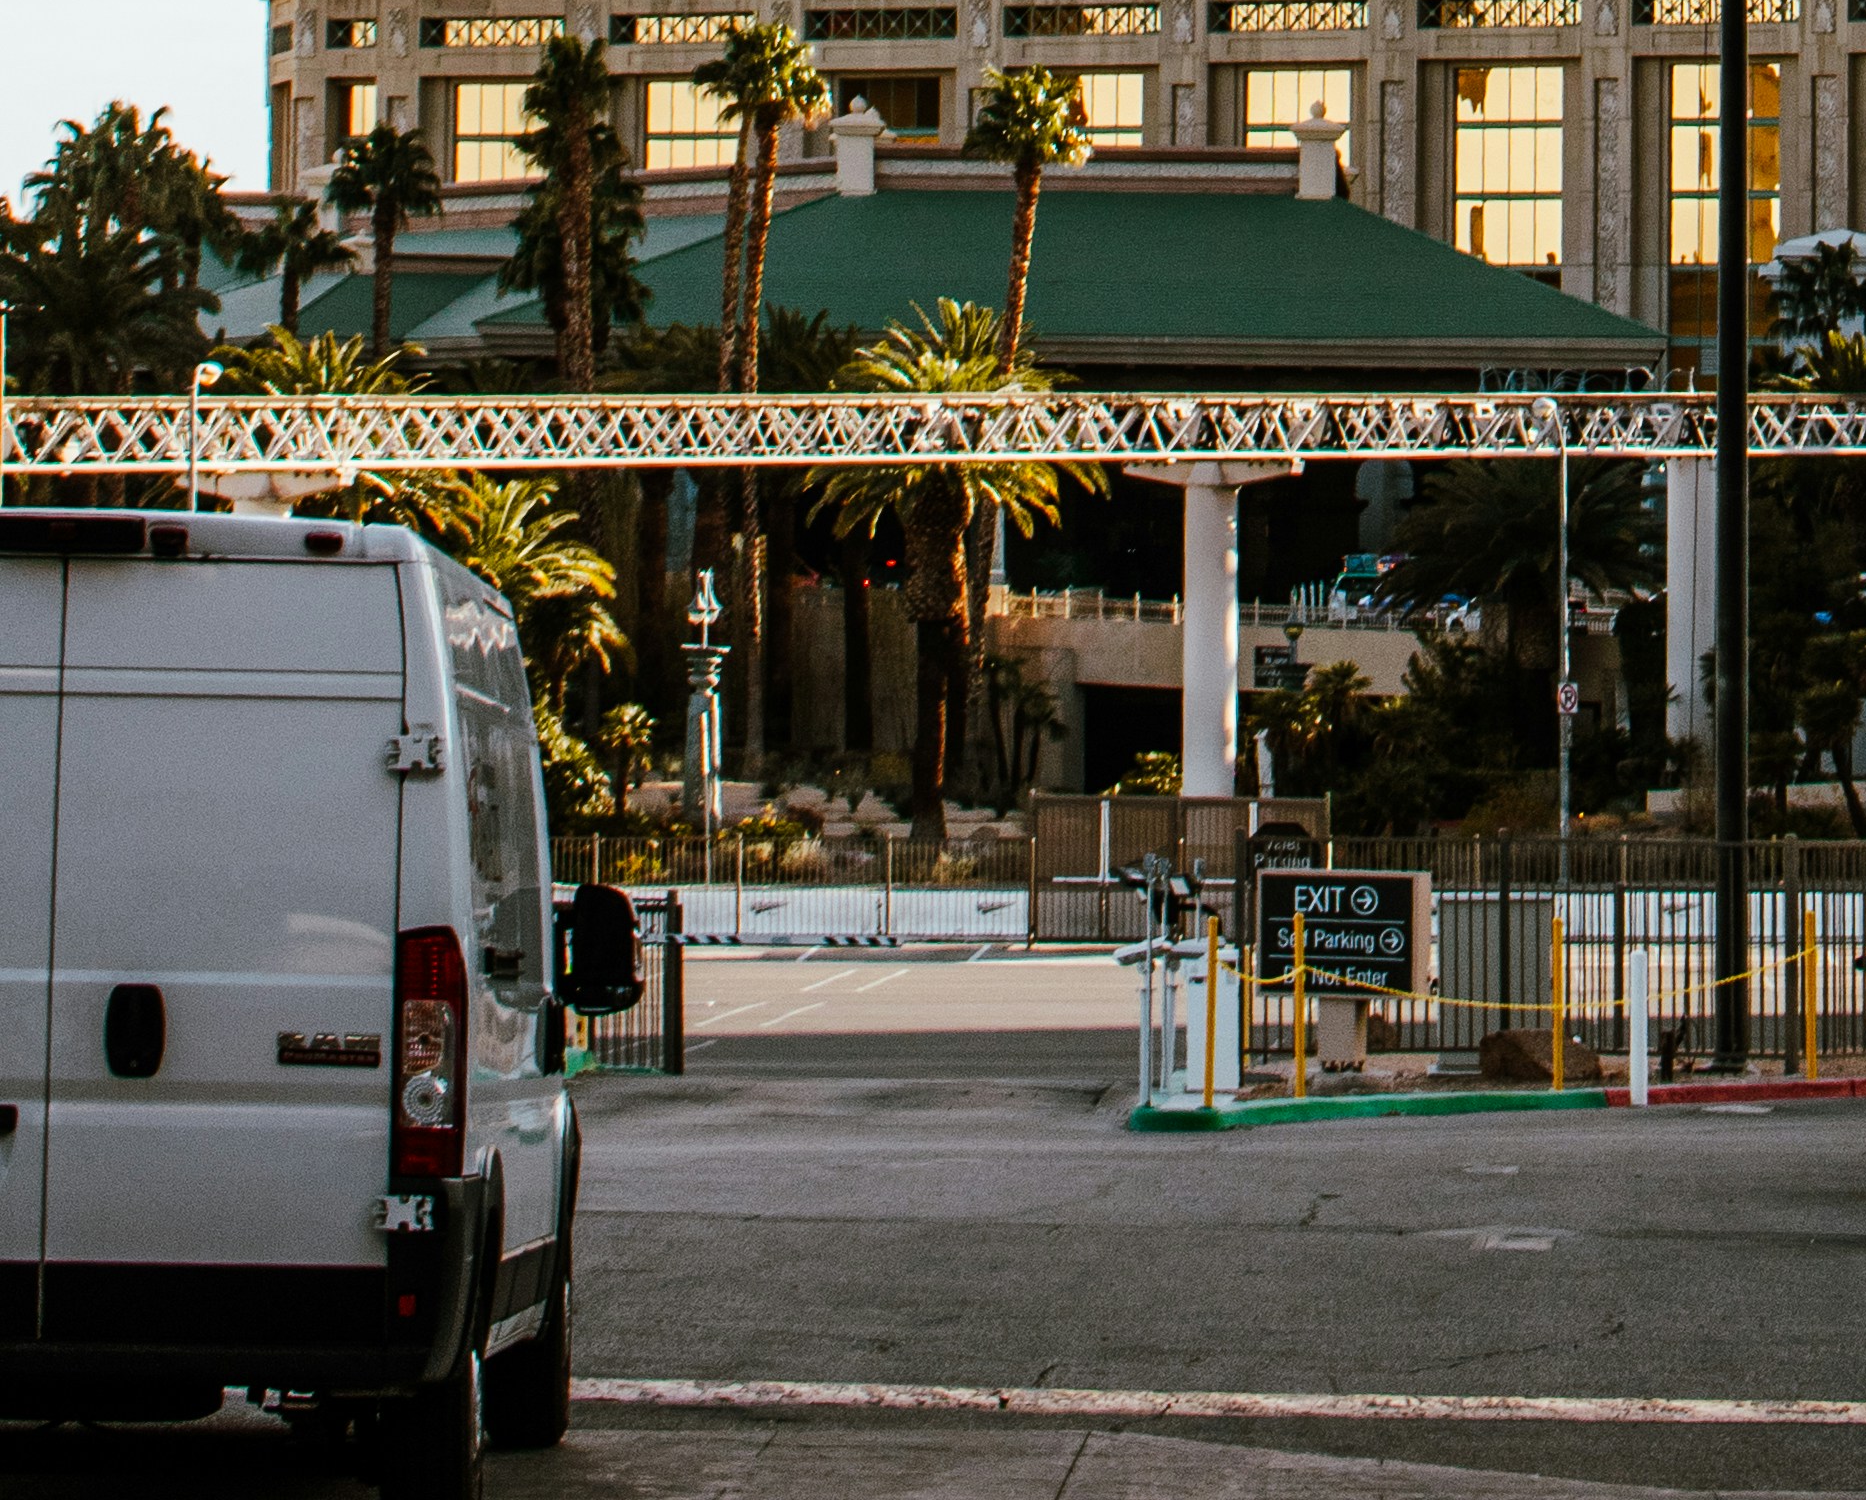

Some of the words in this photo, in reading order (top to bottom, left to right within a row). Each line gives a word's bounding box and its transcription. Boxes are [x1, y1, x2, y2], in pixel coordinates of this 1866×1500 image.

[1294, 885, 1345, 913] EXIT
[1314, 928, 1375, 954] Parking
[1345, 966, 1388, 987] Enter
